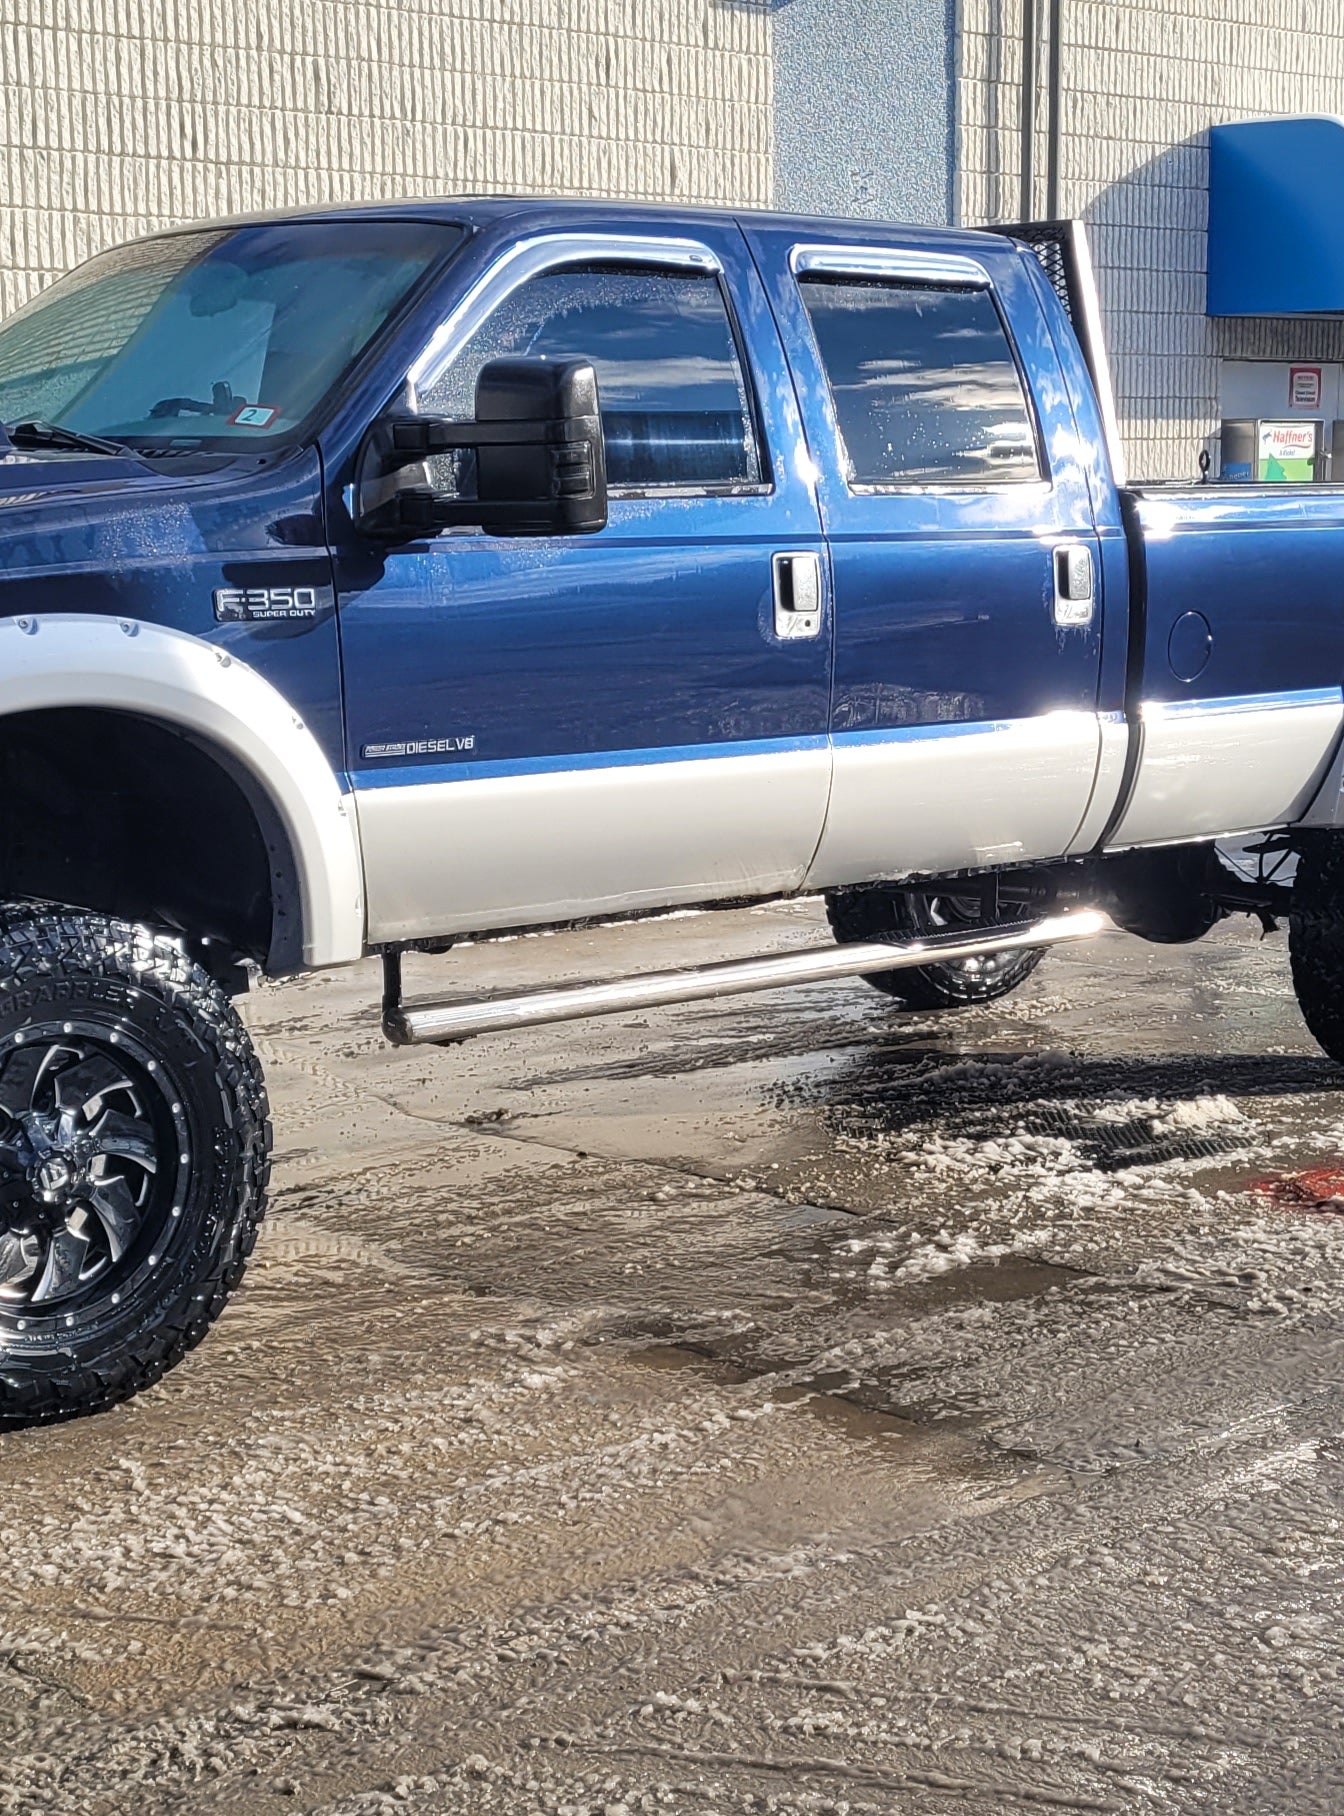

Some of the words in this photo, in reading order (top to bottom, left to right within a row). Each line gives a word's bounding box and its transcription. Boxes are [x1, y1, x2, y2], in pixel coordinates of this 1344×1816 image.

[241, 409, 258, 421] 2
[1273, 430, 1313, 444] Haffner's
[253, 610, 287, 618] SUPER
[289, 609, 316, 617] DUTY
[406, 739, 455, 755] DIESEL
[456, 737, 474, 751] V8
